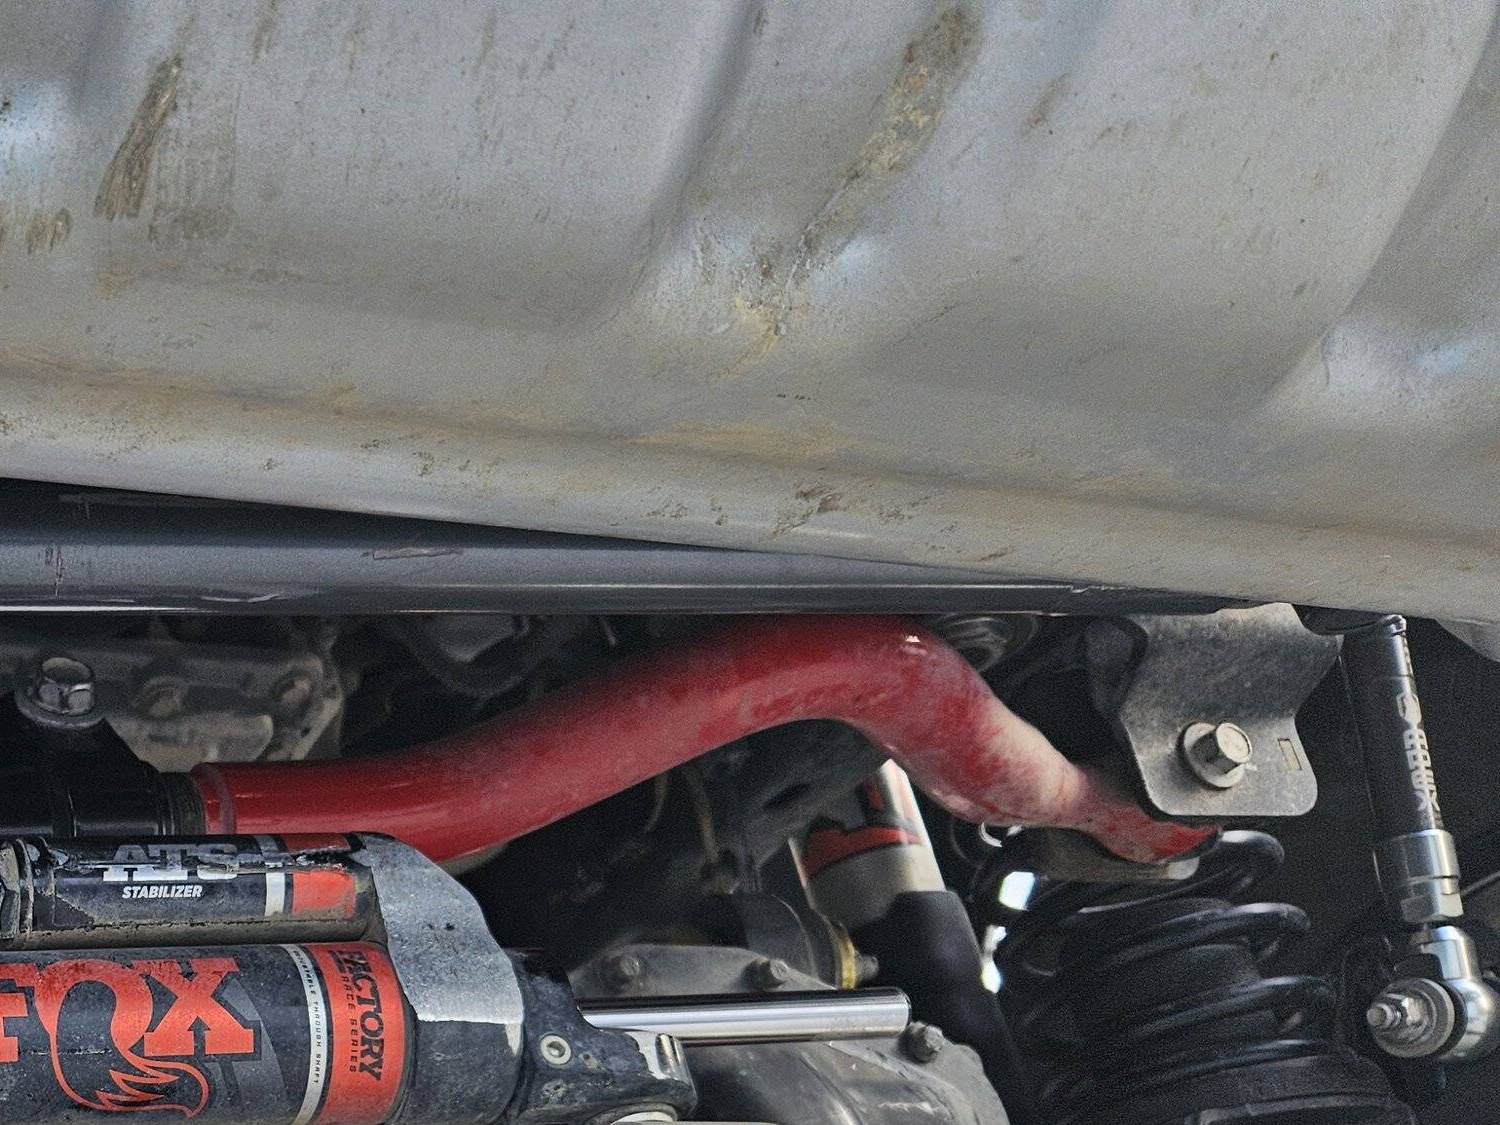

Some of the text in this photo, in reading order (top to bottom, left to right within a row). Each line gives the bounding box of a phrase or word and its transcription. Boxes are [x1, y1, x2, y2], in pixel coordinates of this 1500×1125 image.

[122, 884, 203, 899] STABILIZER
[340, 950, 385, 1081] FACTORY
[340, 974, 359, 1073] RACE SERIES
